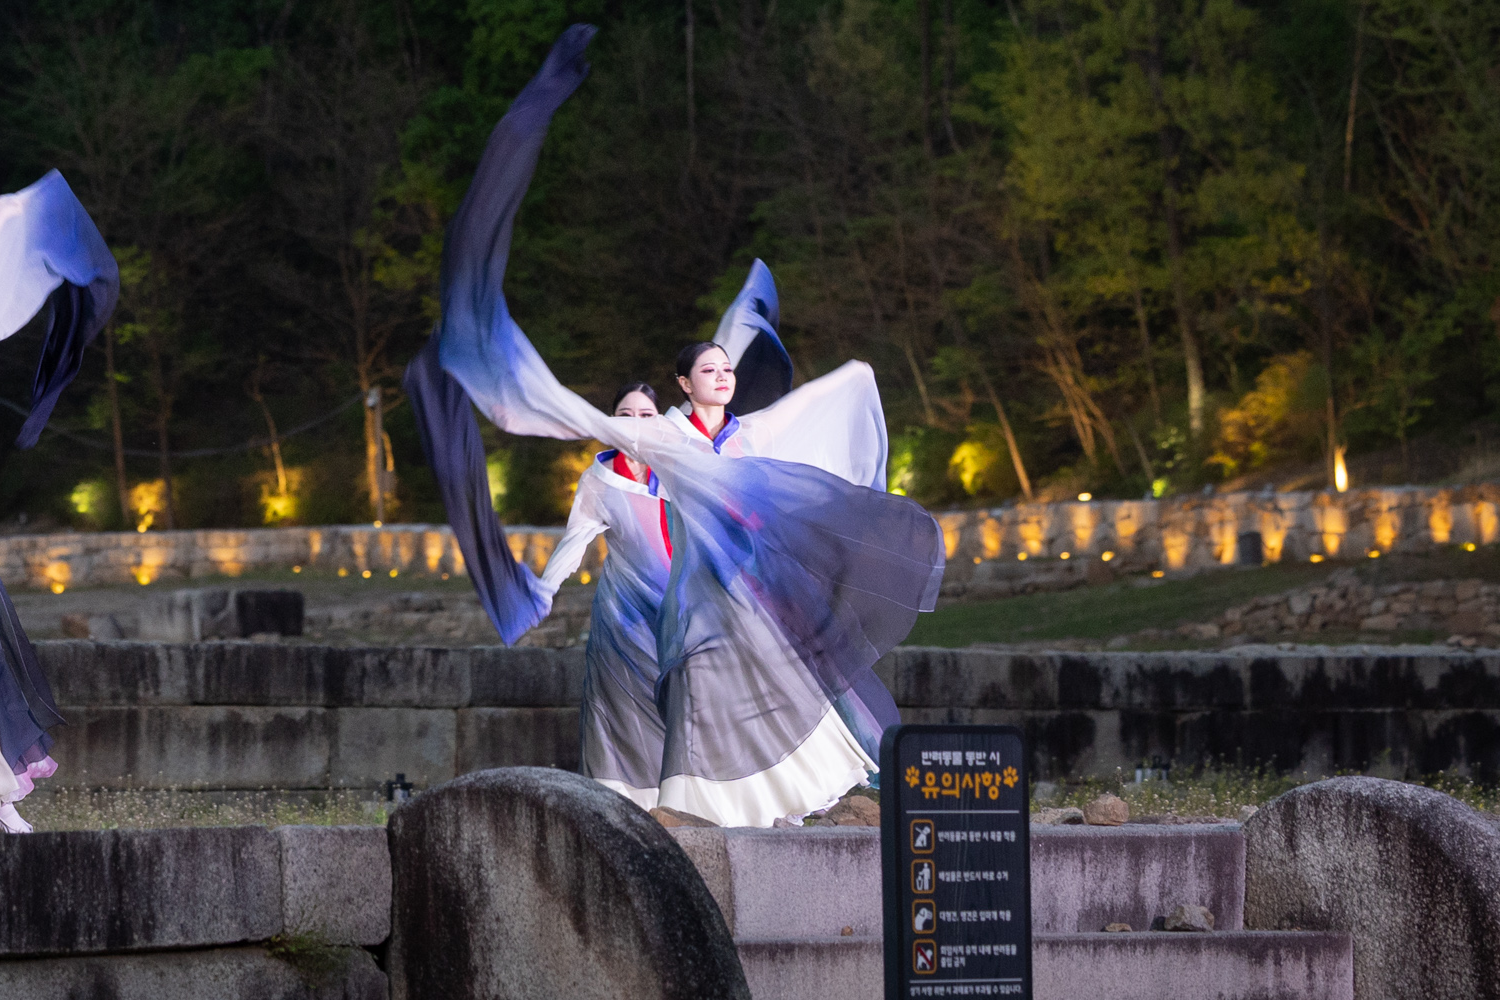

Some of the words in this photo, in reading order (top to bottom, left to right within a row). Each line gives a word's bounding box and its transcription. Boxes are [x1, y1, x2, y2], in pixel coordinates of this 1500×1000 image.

[921, 751, 962, 766] 반려동물
[965, 751, 986, 766] 동반
[989, 751, 1000, 766] 시
[921, 771, 1002, 800] 유의사항
